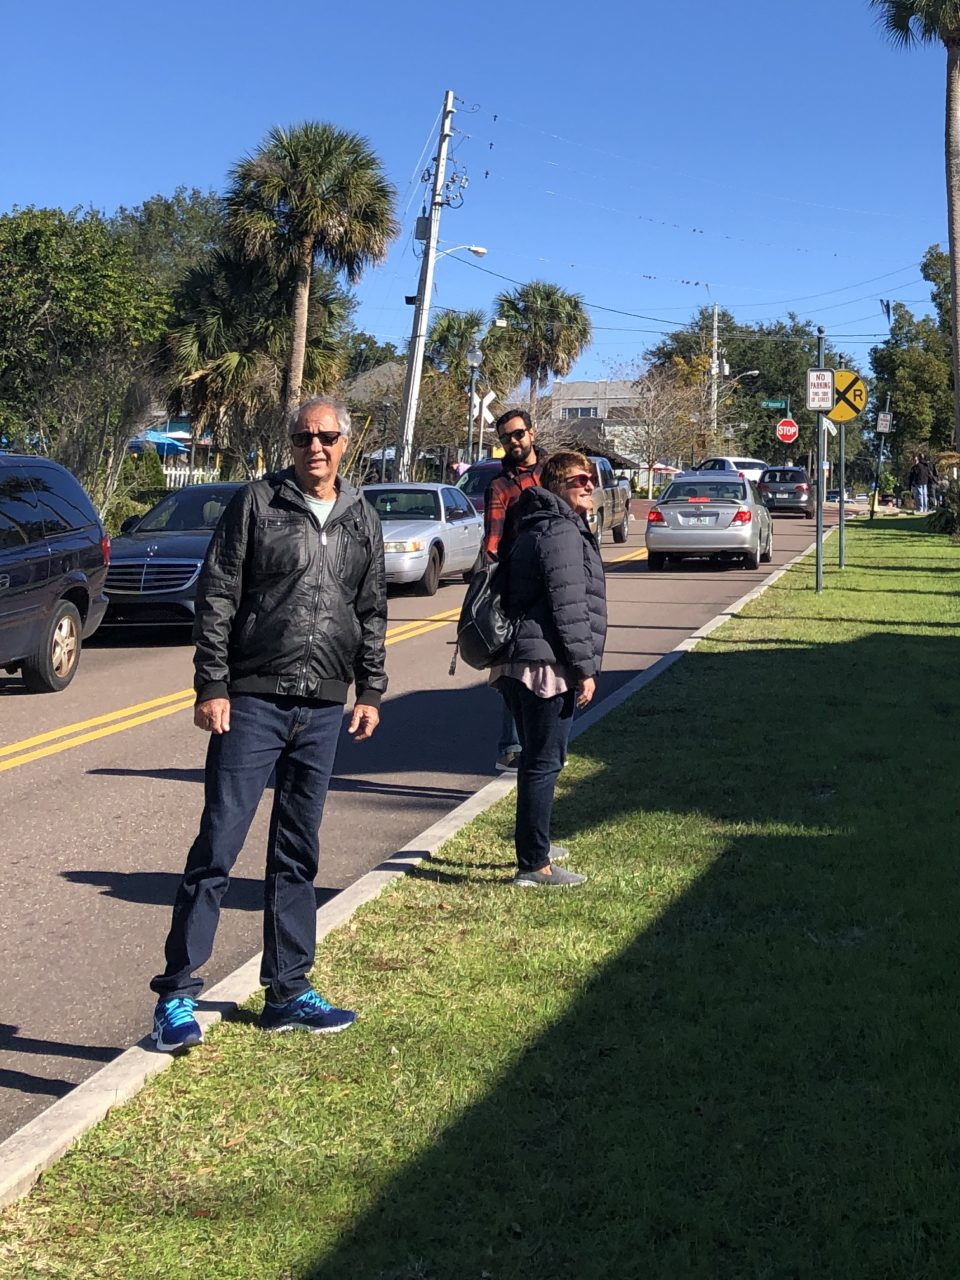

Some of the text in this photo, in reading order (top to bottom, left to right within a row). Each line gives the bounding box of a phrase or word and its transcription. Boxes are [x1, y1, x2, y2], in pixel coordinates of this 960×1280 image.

[816, 373, 826, 381] NO
[853, 389, 863, 402] R
[778, 426, 797, 435] STOP
